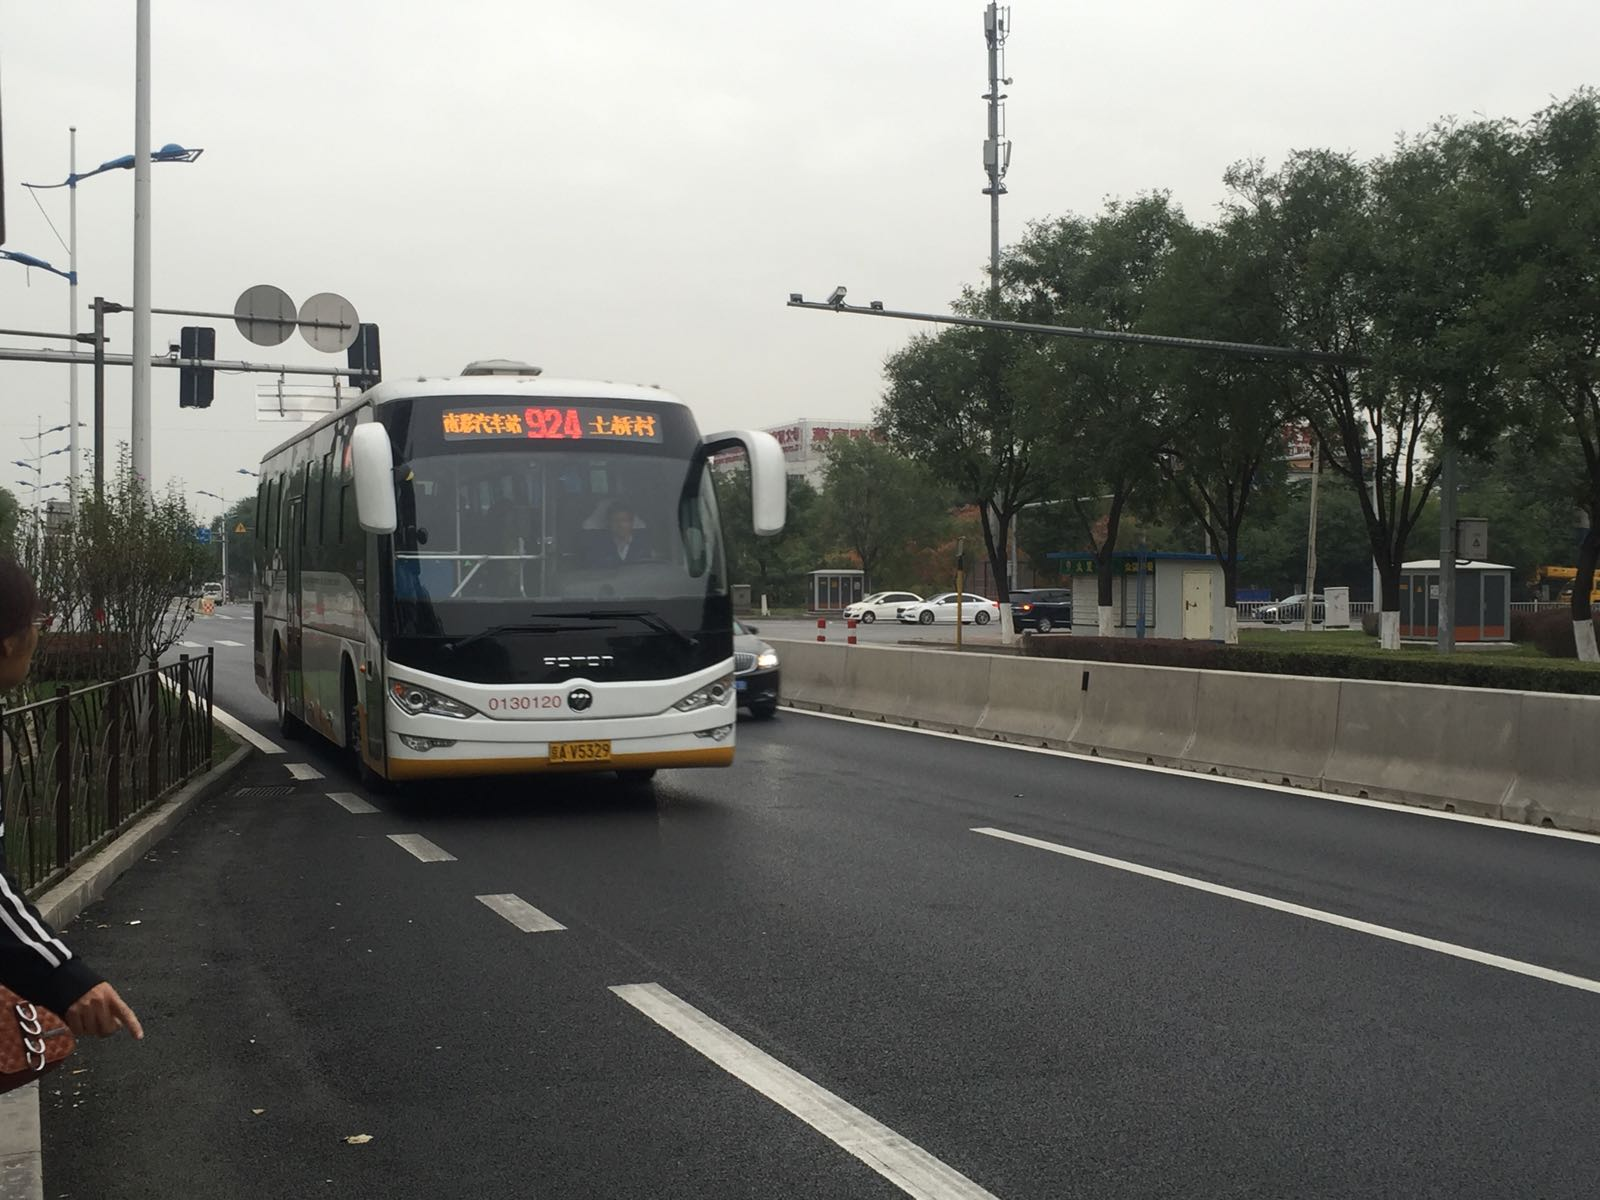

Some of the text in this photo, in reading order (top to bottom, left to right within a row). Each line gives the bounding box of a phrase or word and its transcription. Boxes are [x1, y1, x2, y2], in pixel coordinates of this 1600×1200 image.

[524, 408, 583, 439] 924
[588, 415, 656, 437] 土桥村
[489, 695, 562, 711] 0130120
